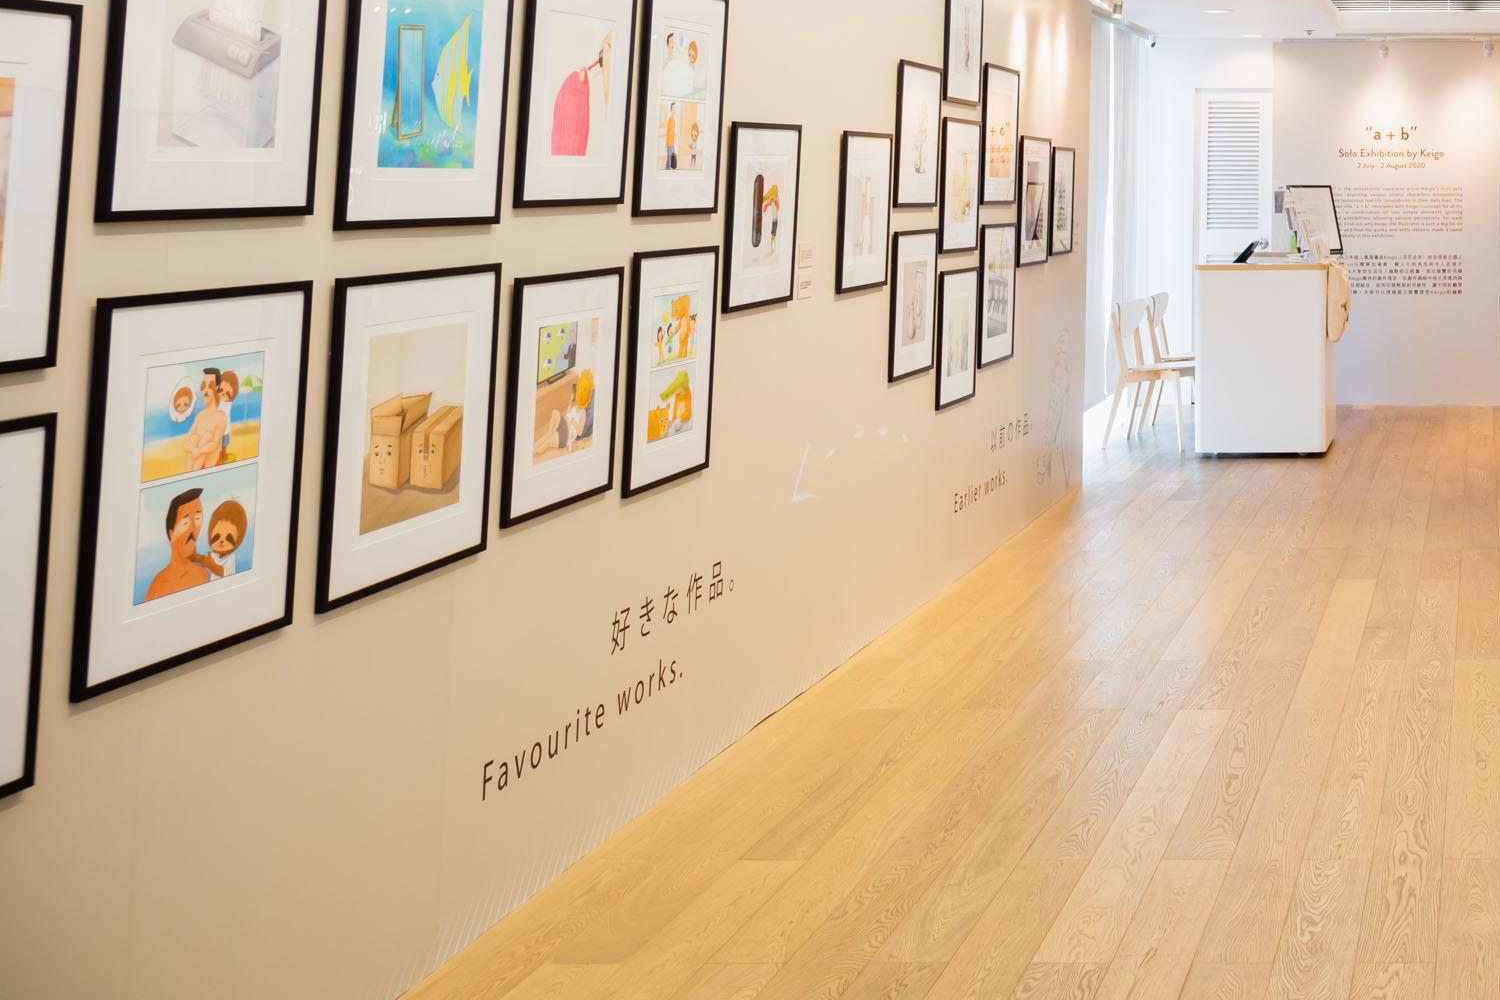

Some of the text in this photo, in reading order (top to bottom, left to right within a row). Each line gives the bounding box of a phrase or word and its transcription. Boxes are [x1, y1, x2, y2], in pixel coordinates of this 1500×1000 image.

[1338, 149, 1445, 161] Solo Exhibition by Keigo
[953, 468, 1008, 514] Earlier works.
[610, 560, 735, 656] 好きな作品。
[481, 658, 683, 802] Favourite works.
